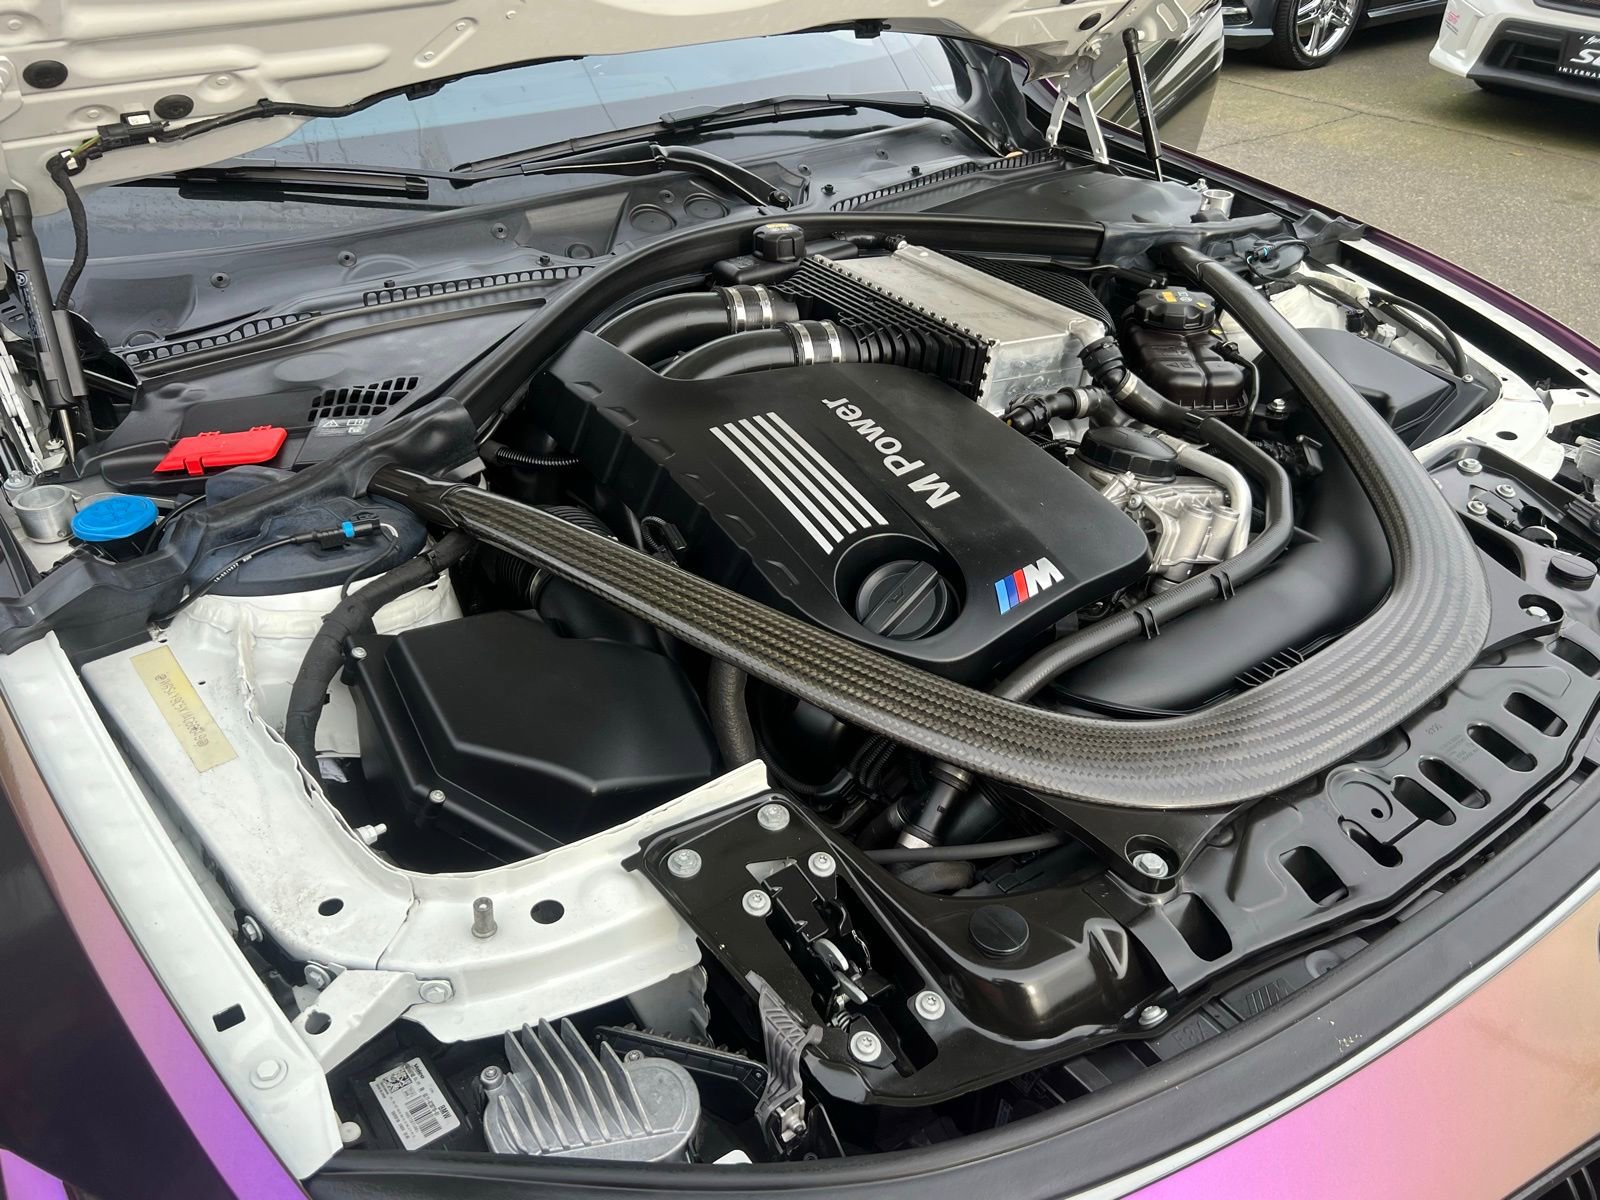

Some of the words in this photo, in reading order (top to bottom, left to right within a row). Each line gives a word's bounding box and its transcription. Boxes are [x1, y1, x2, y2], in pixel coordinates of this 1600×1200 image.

[821, 398, 926, 477] Power
[907, 472, 961, 509] M
[1022, 556, 1065, 596] M
